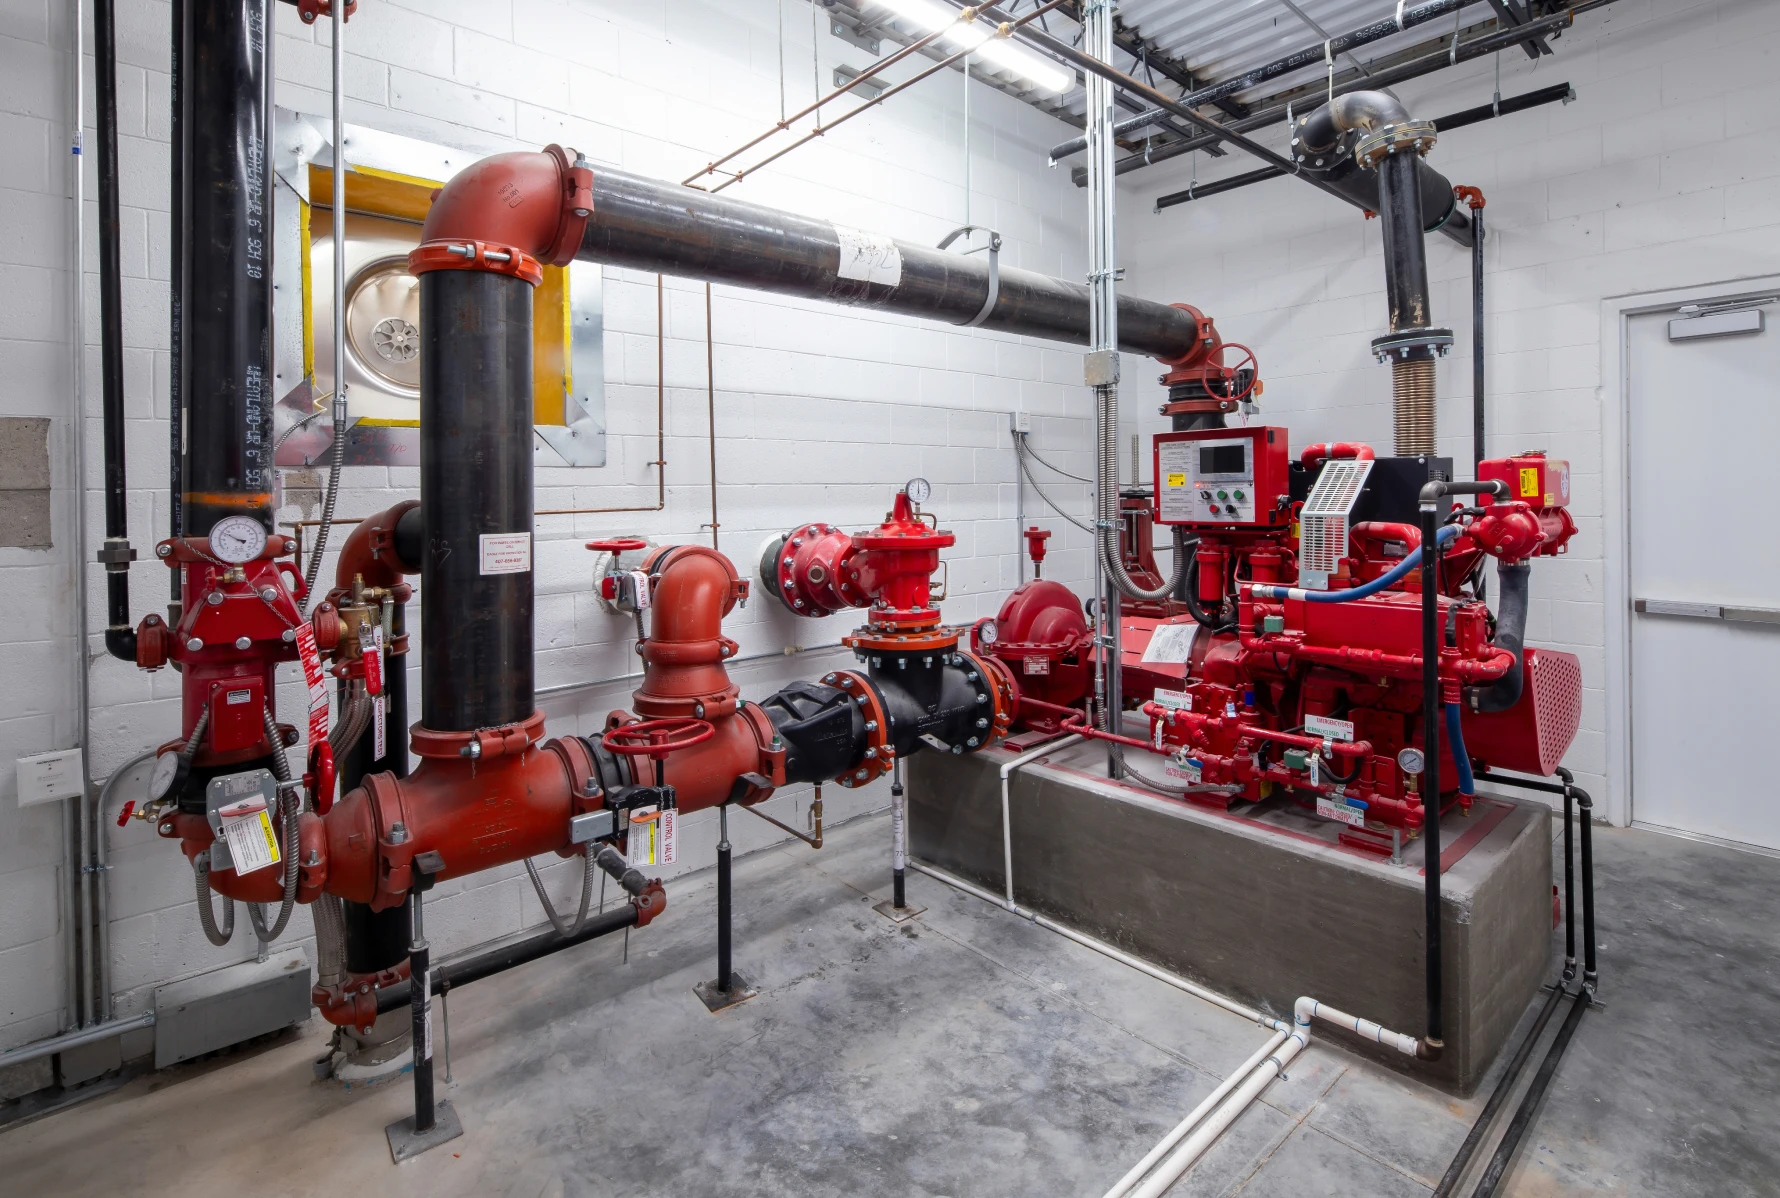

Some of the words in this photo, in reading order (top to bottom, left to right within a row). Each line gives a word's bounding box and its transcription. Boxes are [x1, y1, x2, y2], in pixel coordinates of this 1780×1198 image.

[1286, 47, 1320, 66] RATED
[1266, 61, 1284, 74] 300
[248, 238, 262, 260] SCH
[246, 469, 261, 490] SCH
[1306, 726, 1339, 737] NORMAL/CLOSED
[1316, 717, 1353, 729] EMERGENCY/OPEN
[1335, 803, 1363, 814] NORMAL/OPEN
[664, 813, 673, 841] CONTROL
[664, 842, 672, 862] VALVE
